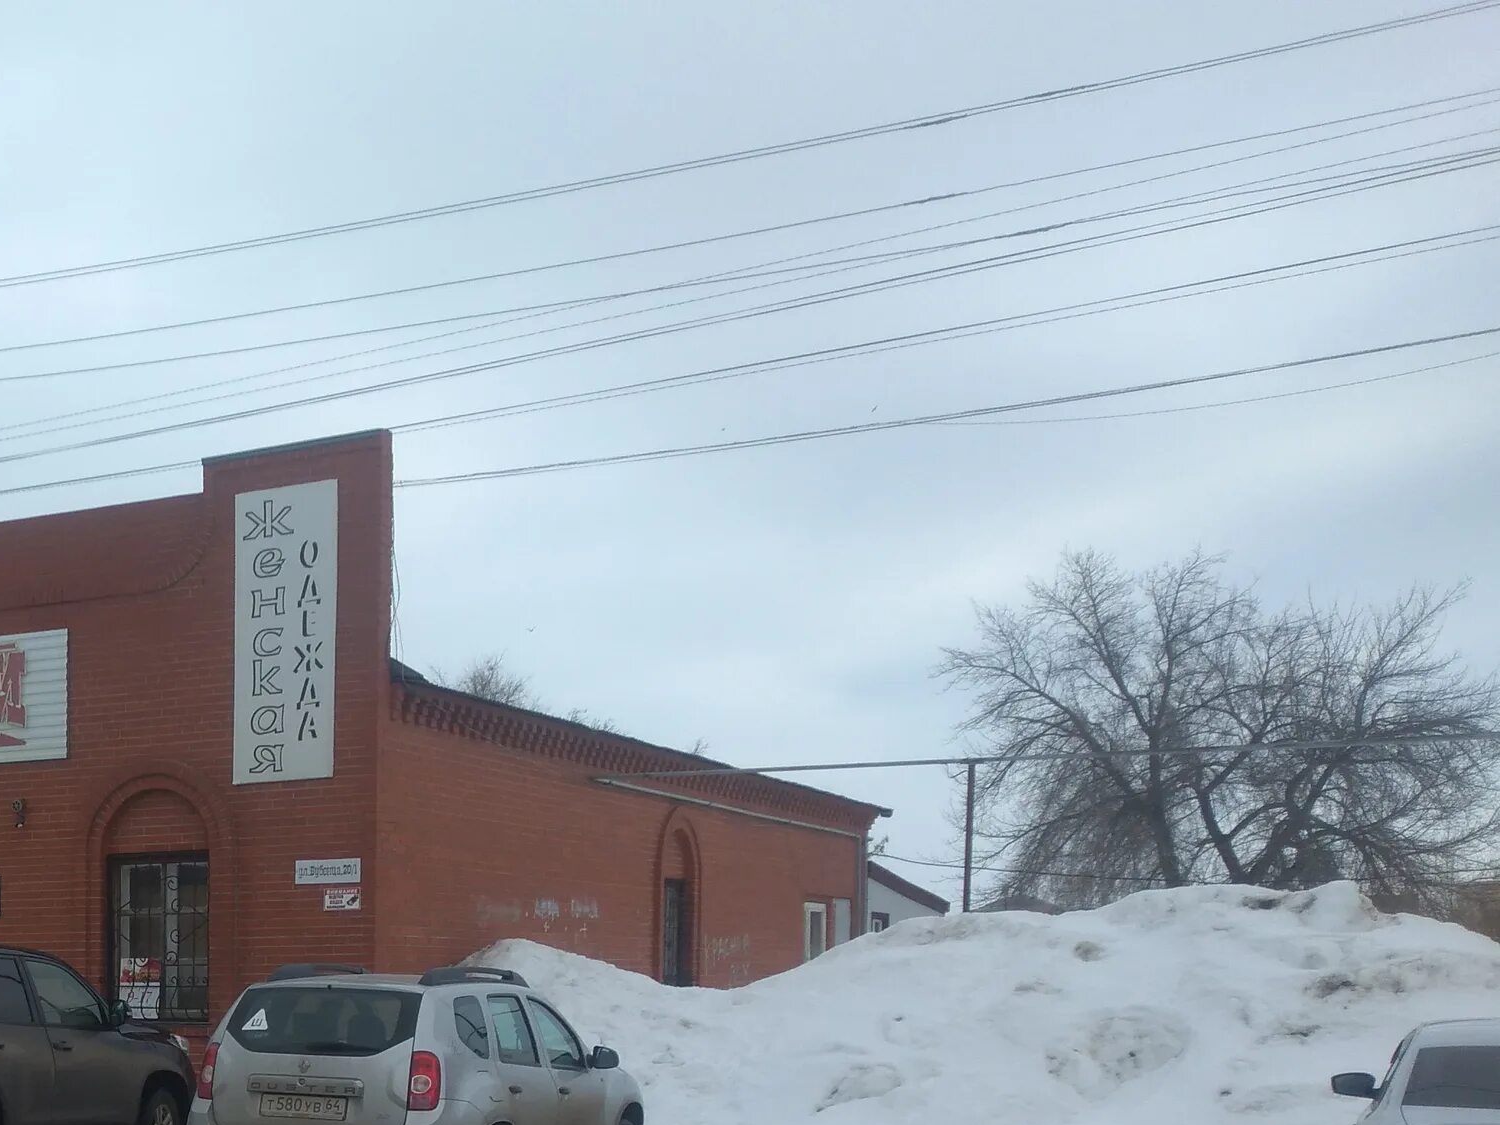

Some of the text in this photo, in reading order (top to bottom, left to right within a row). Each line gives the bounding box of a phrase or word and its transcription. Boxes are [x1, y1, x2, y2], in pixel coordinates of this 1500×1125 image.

[243, 500, 294, 774] Женская
[293, 540, 323, 741] ОДЕЖДА
[251, 1081, 356, 1095] DUSTER
[325, 1098, 340, 1110] 64
